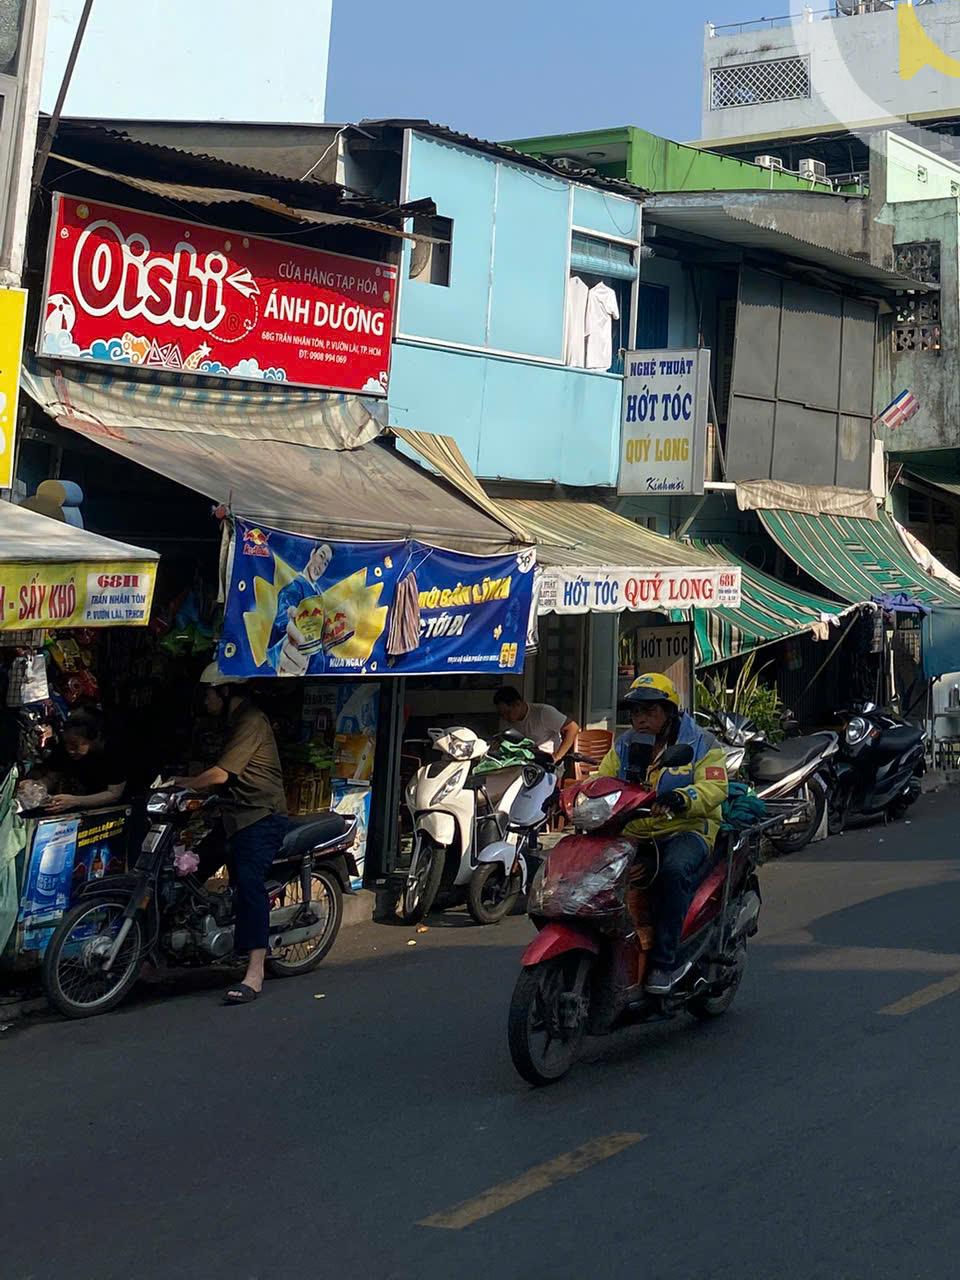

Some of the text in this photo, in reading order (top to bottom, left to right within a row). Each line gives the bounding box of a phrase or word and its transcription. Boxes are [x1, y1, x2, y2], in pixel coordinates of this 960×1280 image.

[73, 219, 228, 331] Oishi
[279, 261, 378, 295] CỬA HÀNG TẠP HÓA
[264, 288, 384, 336] ÁNH DƯƠNG
[261, 331, 274, 341] 68G
[293, 335, 312, 346] NHÂN
[369, 347, 382, 356] HCM
[630, 357, 693, 378] NGHỆ THUẬT
[626, 384, 692, 422] HỚT TÓC
[626, 433, 689, 464] QUÝ LONG
[19, 573, 46, 620] SẤY
[48, 576, 77, 619] KHÔ
[109, 592, 130, 604] NHÂN
[131, 593, 146, 604] TÔN
[563, 574, 590, 606] HỚT
[594, 574, 619, 606] TÓC
[624, 571, 664, 607] QUÝ
[668, 578, 713, 601] LONG
[641, 631, 688, 658] HỚT TÓC
